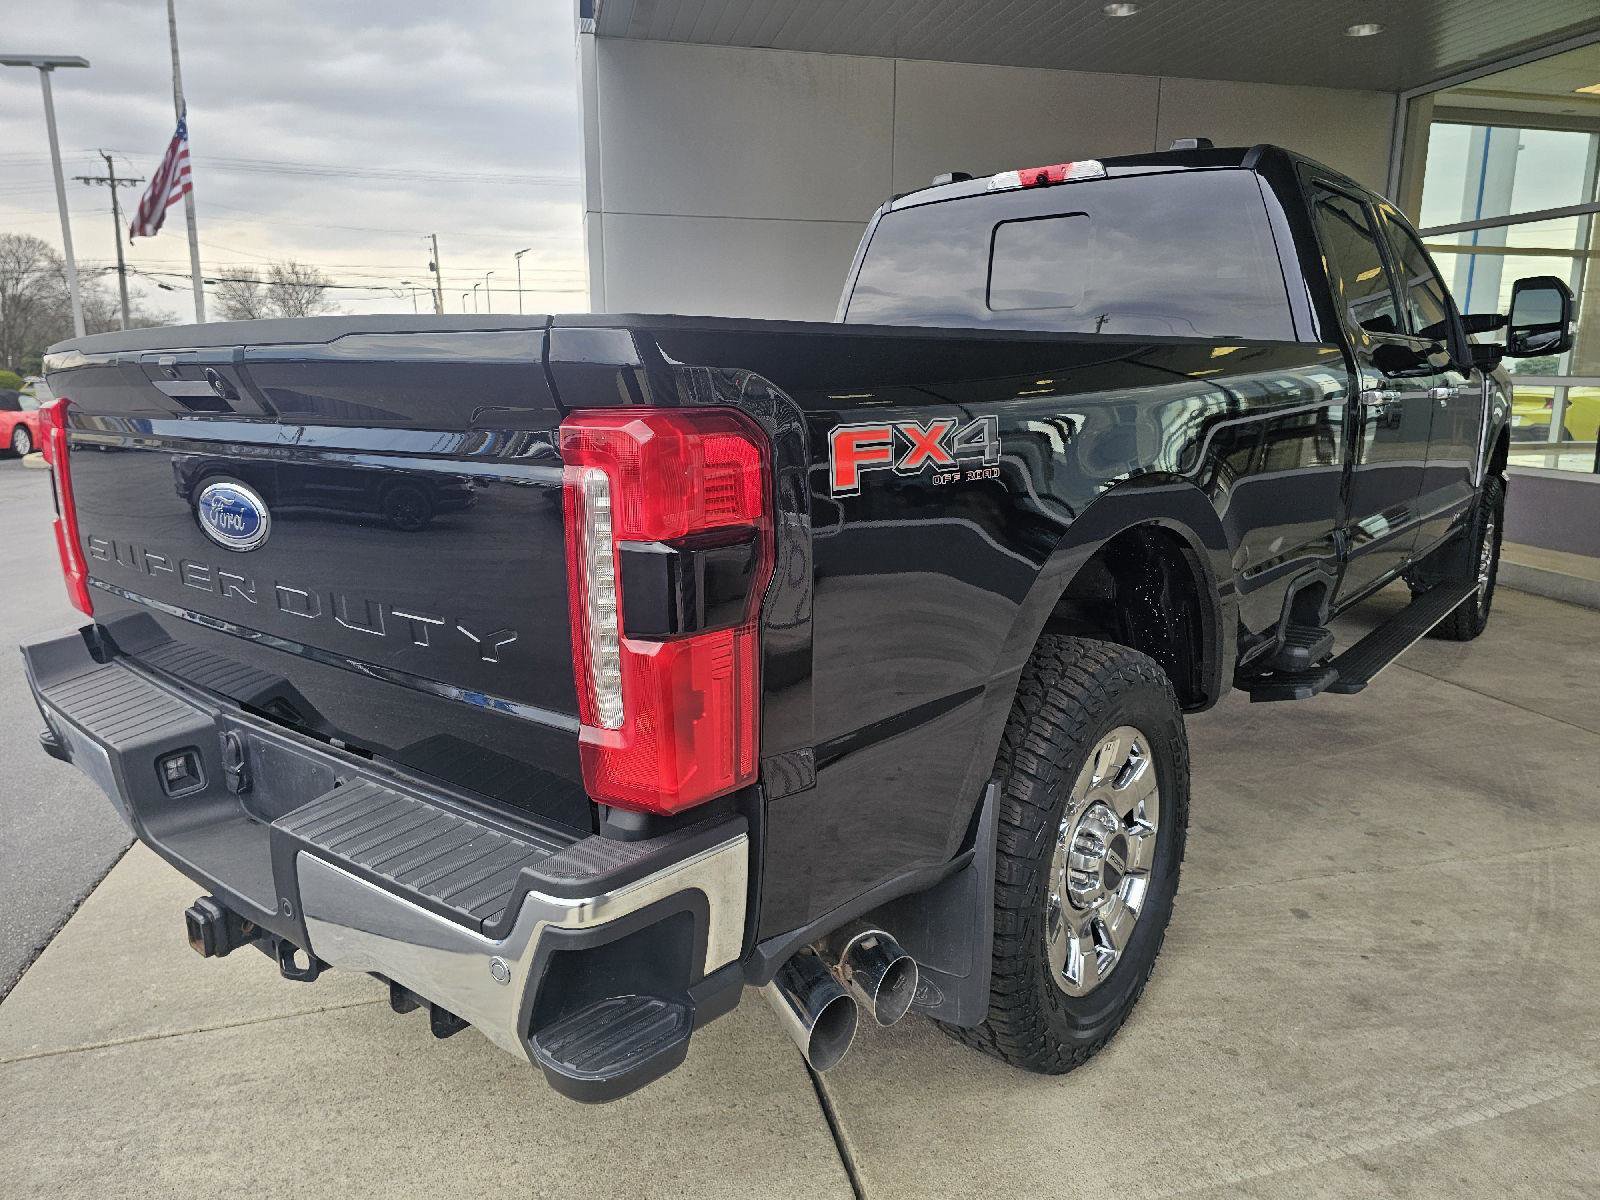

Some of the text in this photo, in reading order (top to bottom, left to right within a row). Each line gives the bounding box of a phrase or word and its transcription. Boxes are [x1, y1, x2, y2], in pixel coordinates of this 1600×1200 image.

[828, 415, 1001, 499] FX4
[932, 467, 1000, 486] OFF ROAD
[210, 495, 246, 532] Ford
[88, 534, 518, 663] SUPER DUTY
